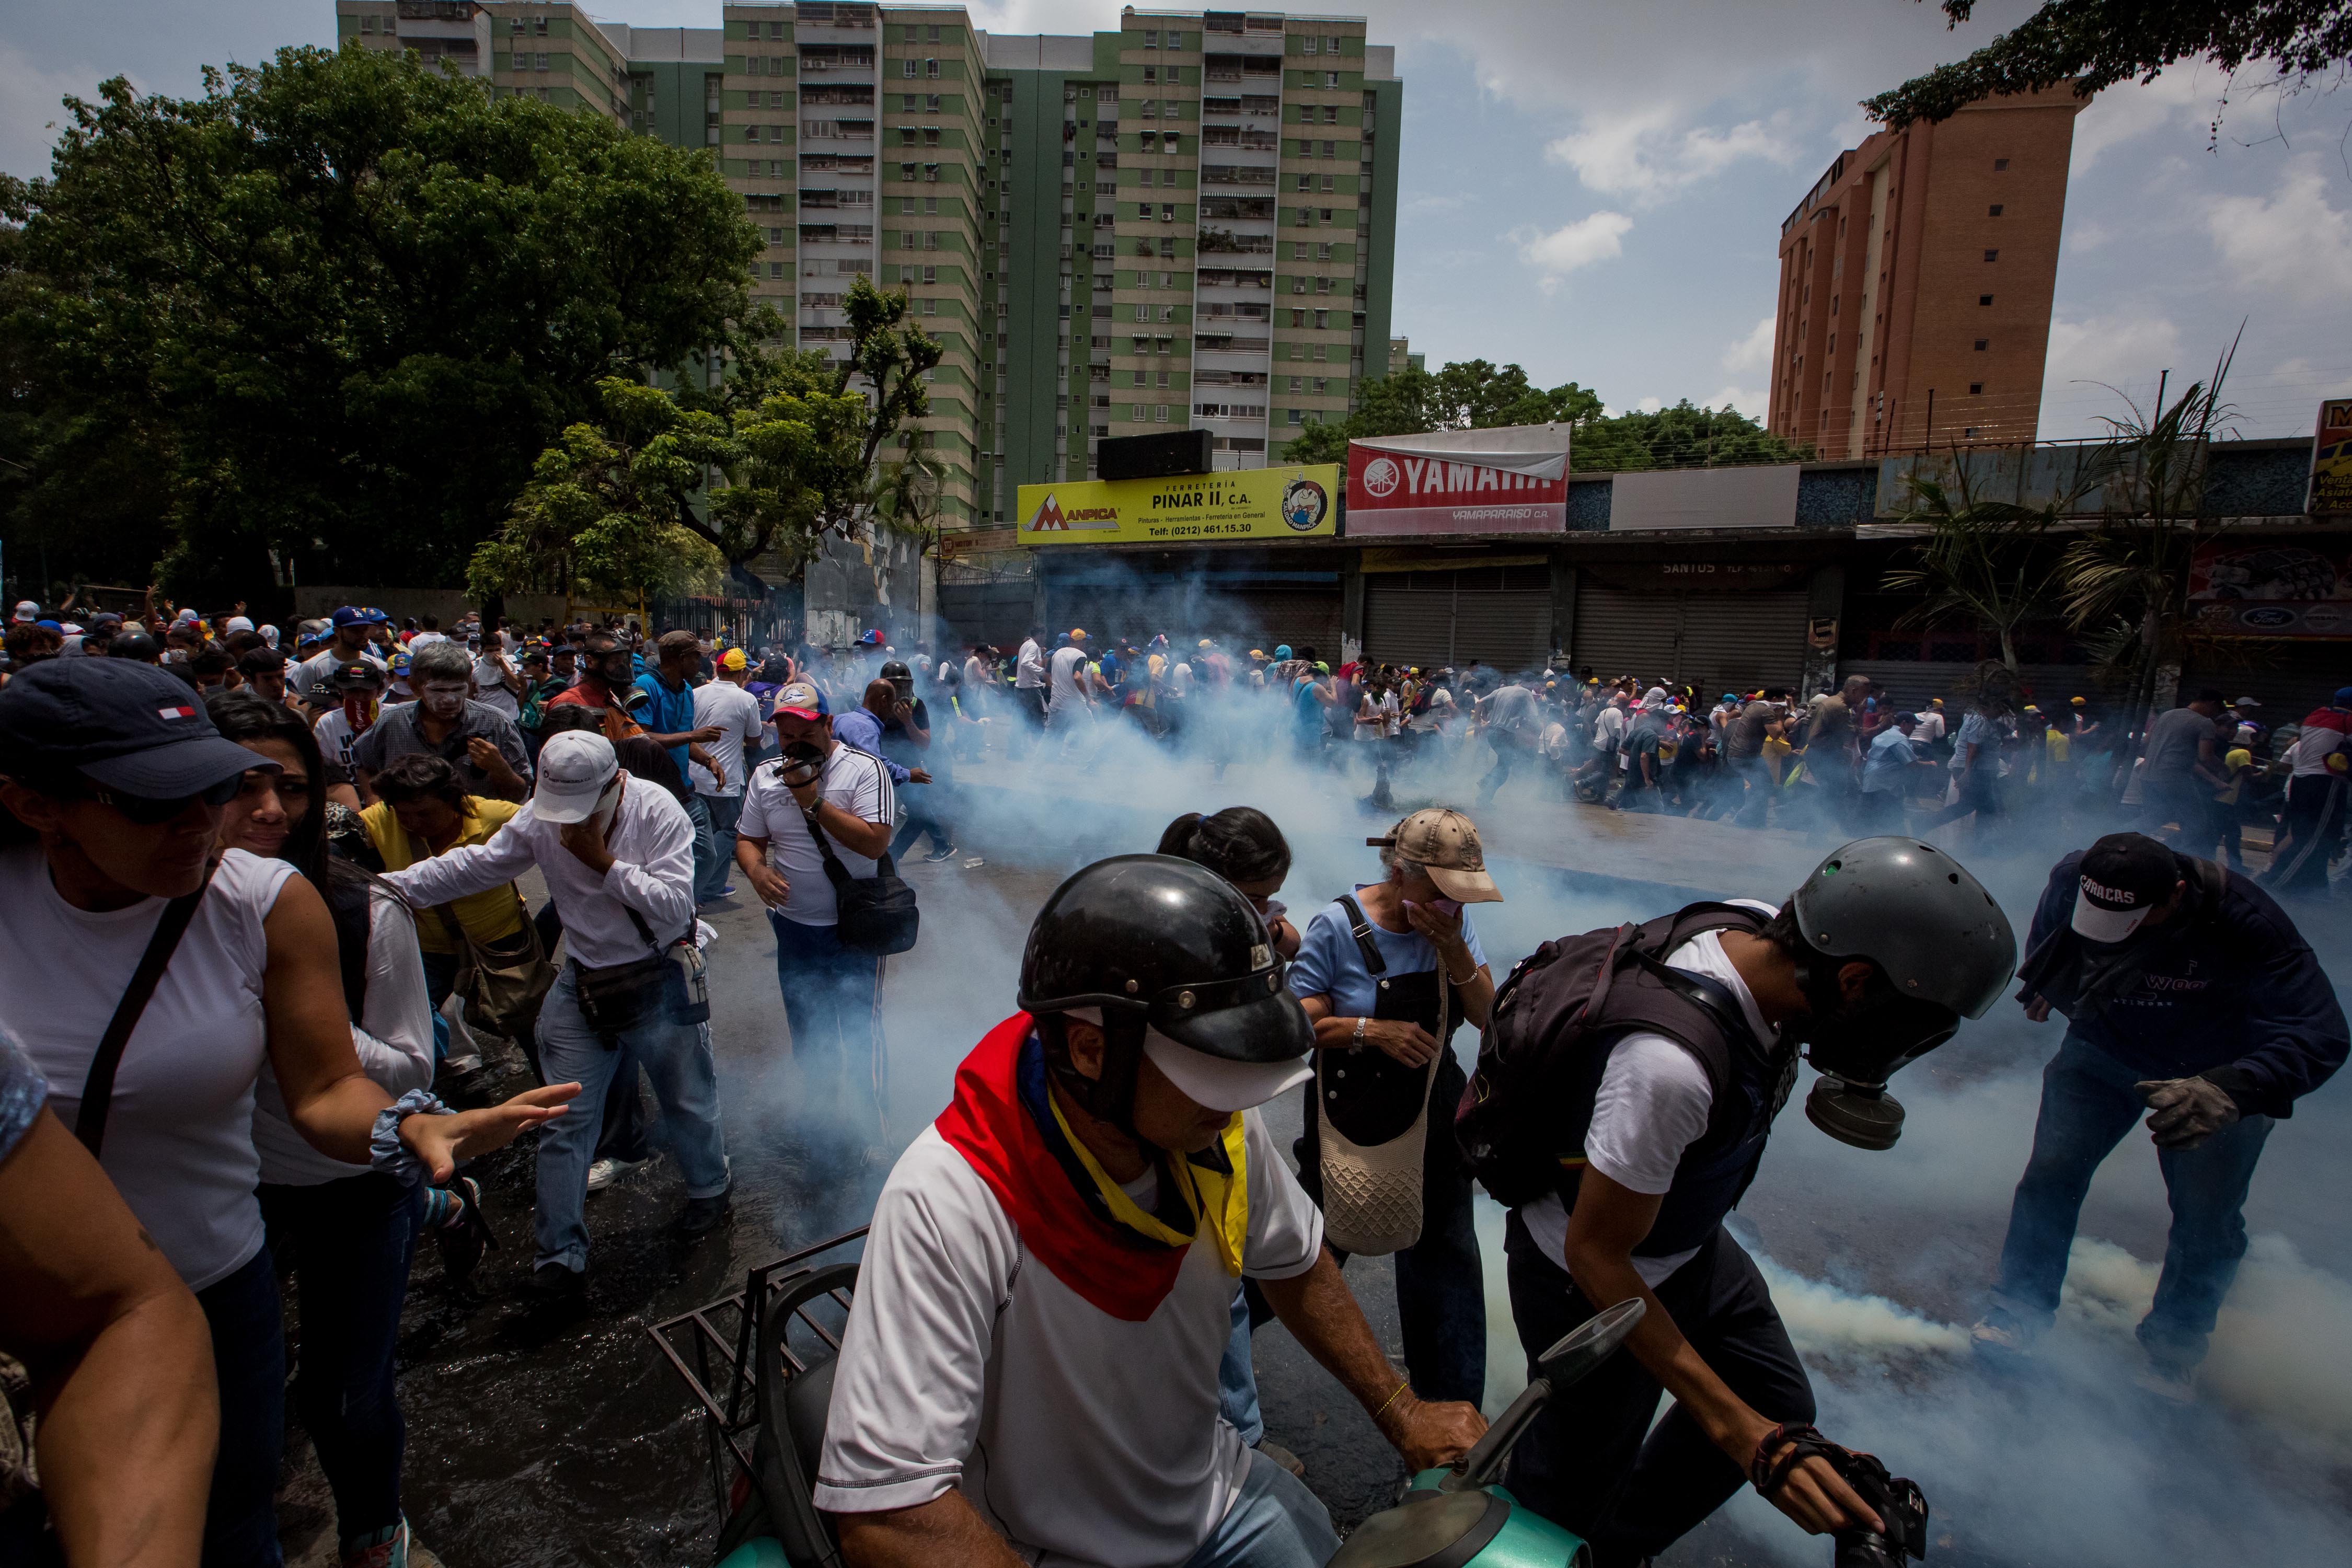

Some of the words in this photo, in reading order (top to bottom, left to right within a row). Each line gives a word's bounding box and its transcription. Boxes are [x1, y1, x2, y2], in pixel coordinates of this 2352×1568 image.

[1166, 480, 1236, 491] FERRETERÍA
[1152, 492, 1203, 509] PINAR
[1228, 494, 1251, 505] C.A.
[1165, 514, 1201, 523] Herramientas
[1283, 501, 1293, 524] CALIDAD
[1452, 509, 1531, 520] YAMAPARAISO
[1149, 527, 1169, 536] Telf:
[1171, 525, 1201, 537] (0212)
[1203, 523, 1251, 534] 461.15.30
[2080, 874, 2135, 904] CARACAS
